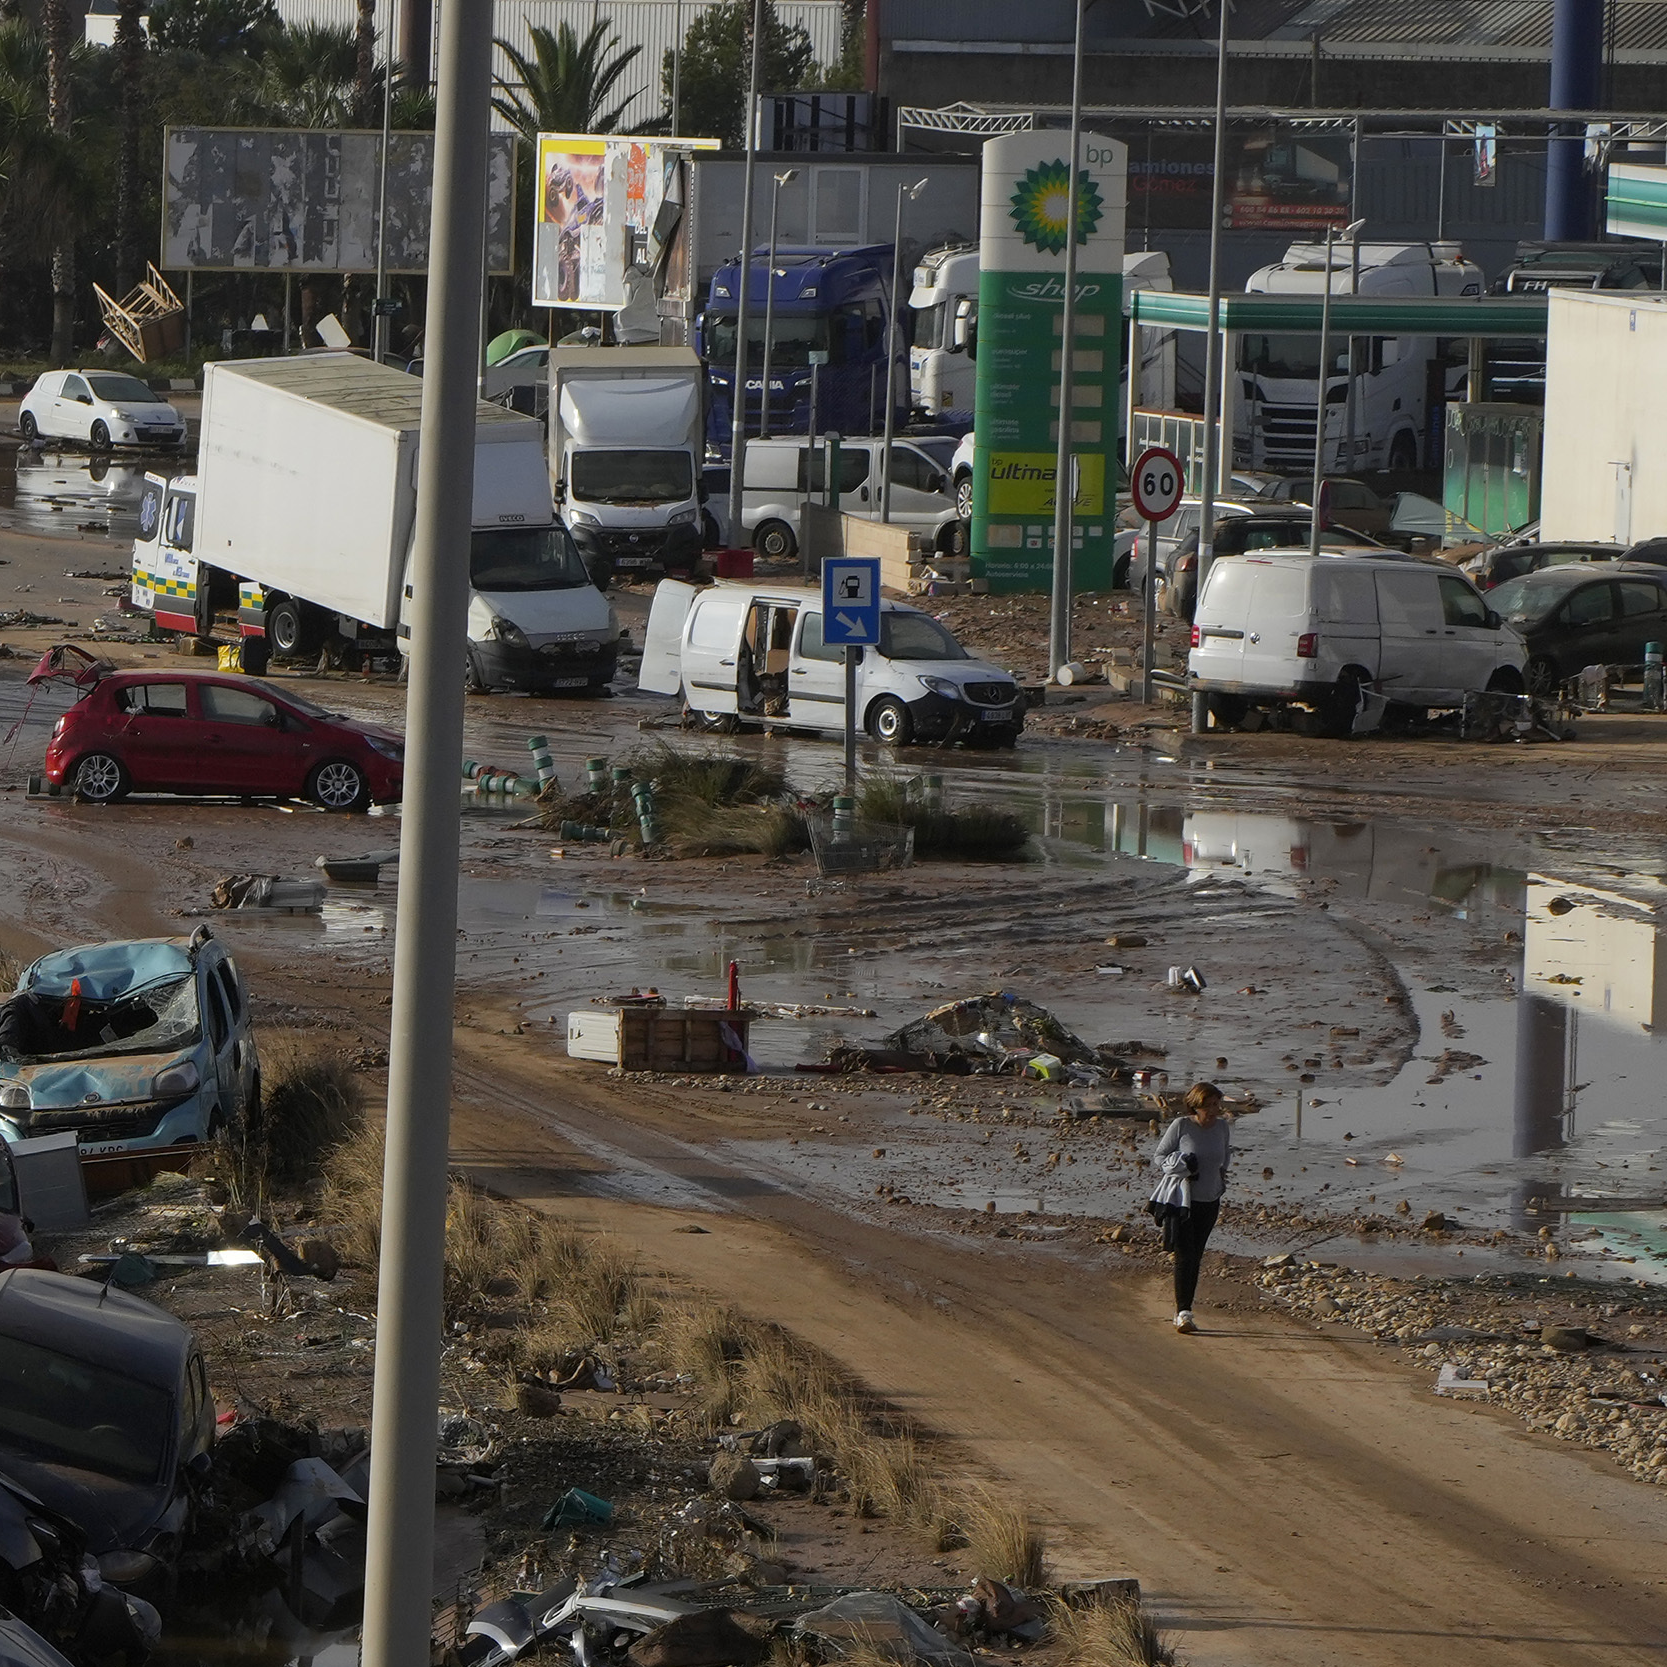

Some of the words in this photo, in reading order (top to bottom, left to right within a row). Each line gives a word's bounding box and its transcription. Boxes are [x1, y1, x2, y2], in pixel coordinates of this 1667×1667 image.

[1087, 144, 1113, 168] bp
[1128, 161, 1215, 175] amiones
[1523, 281, 1548, 291] FH
[745, 380, 785, 390] CAIA
[991, 463, 1058, 481] ultima
[1144, 472, 1174, 496] 60
